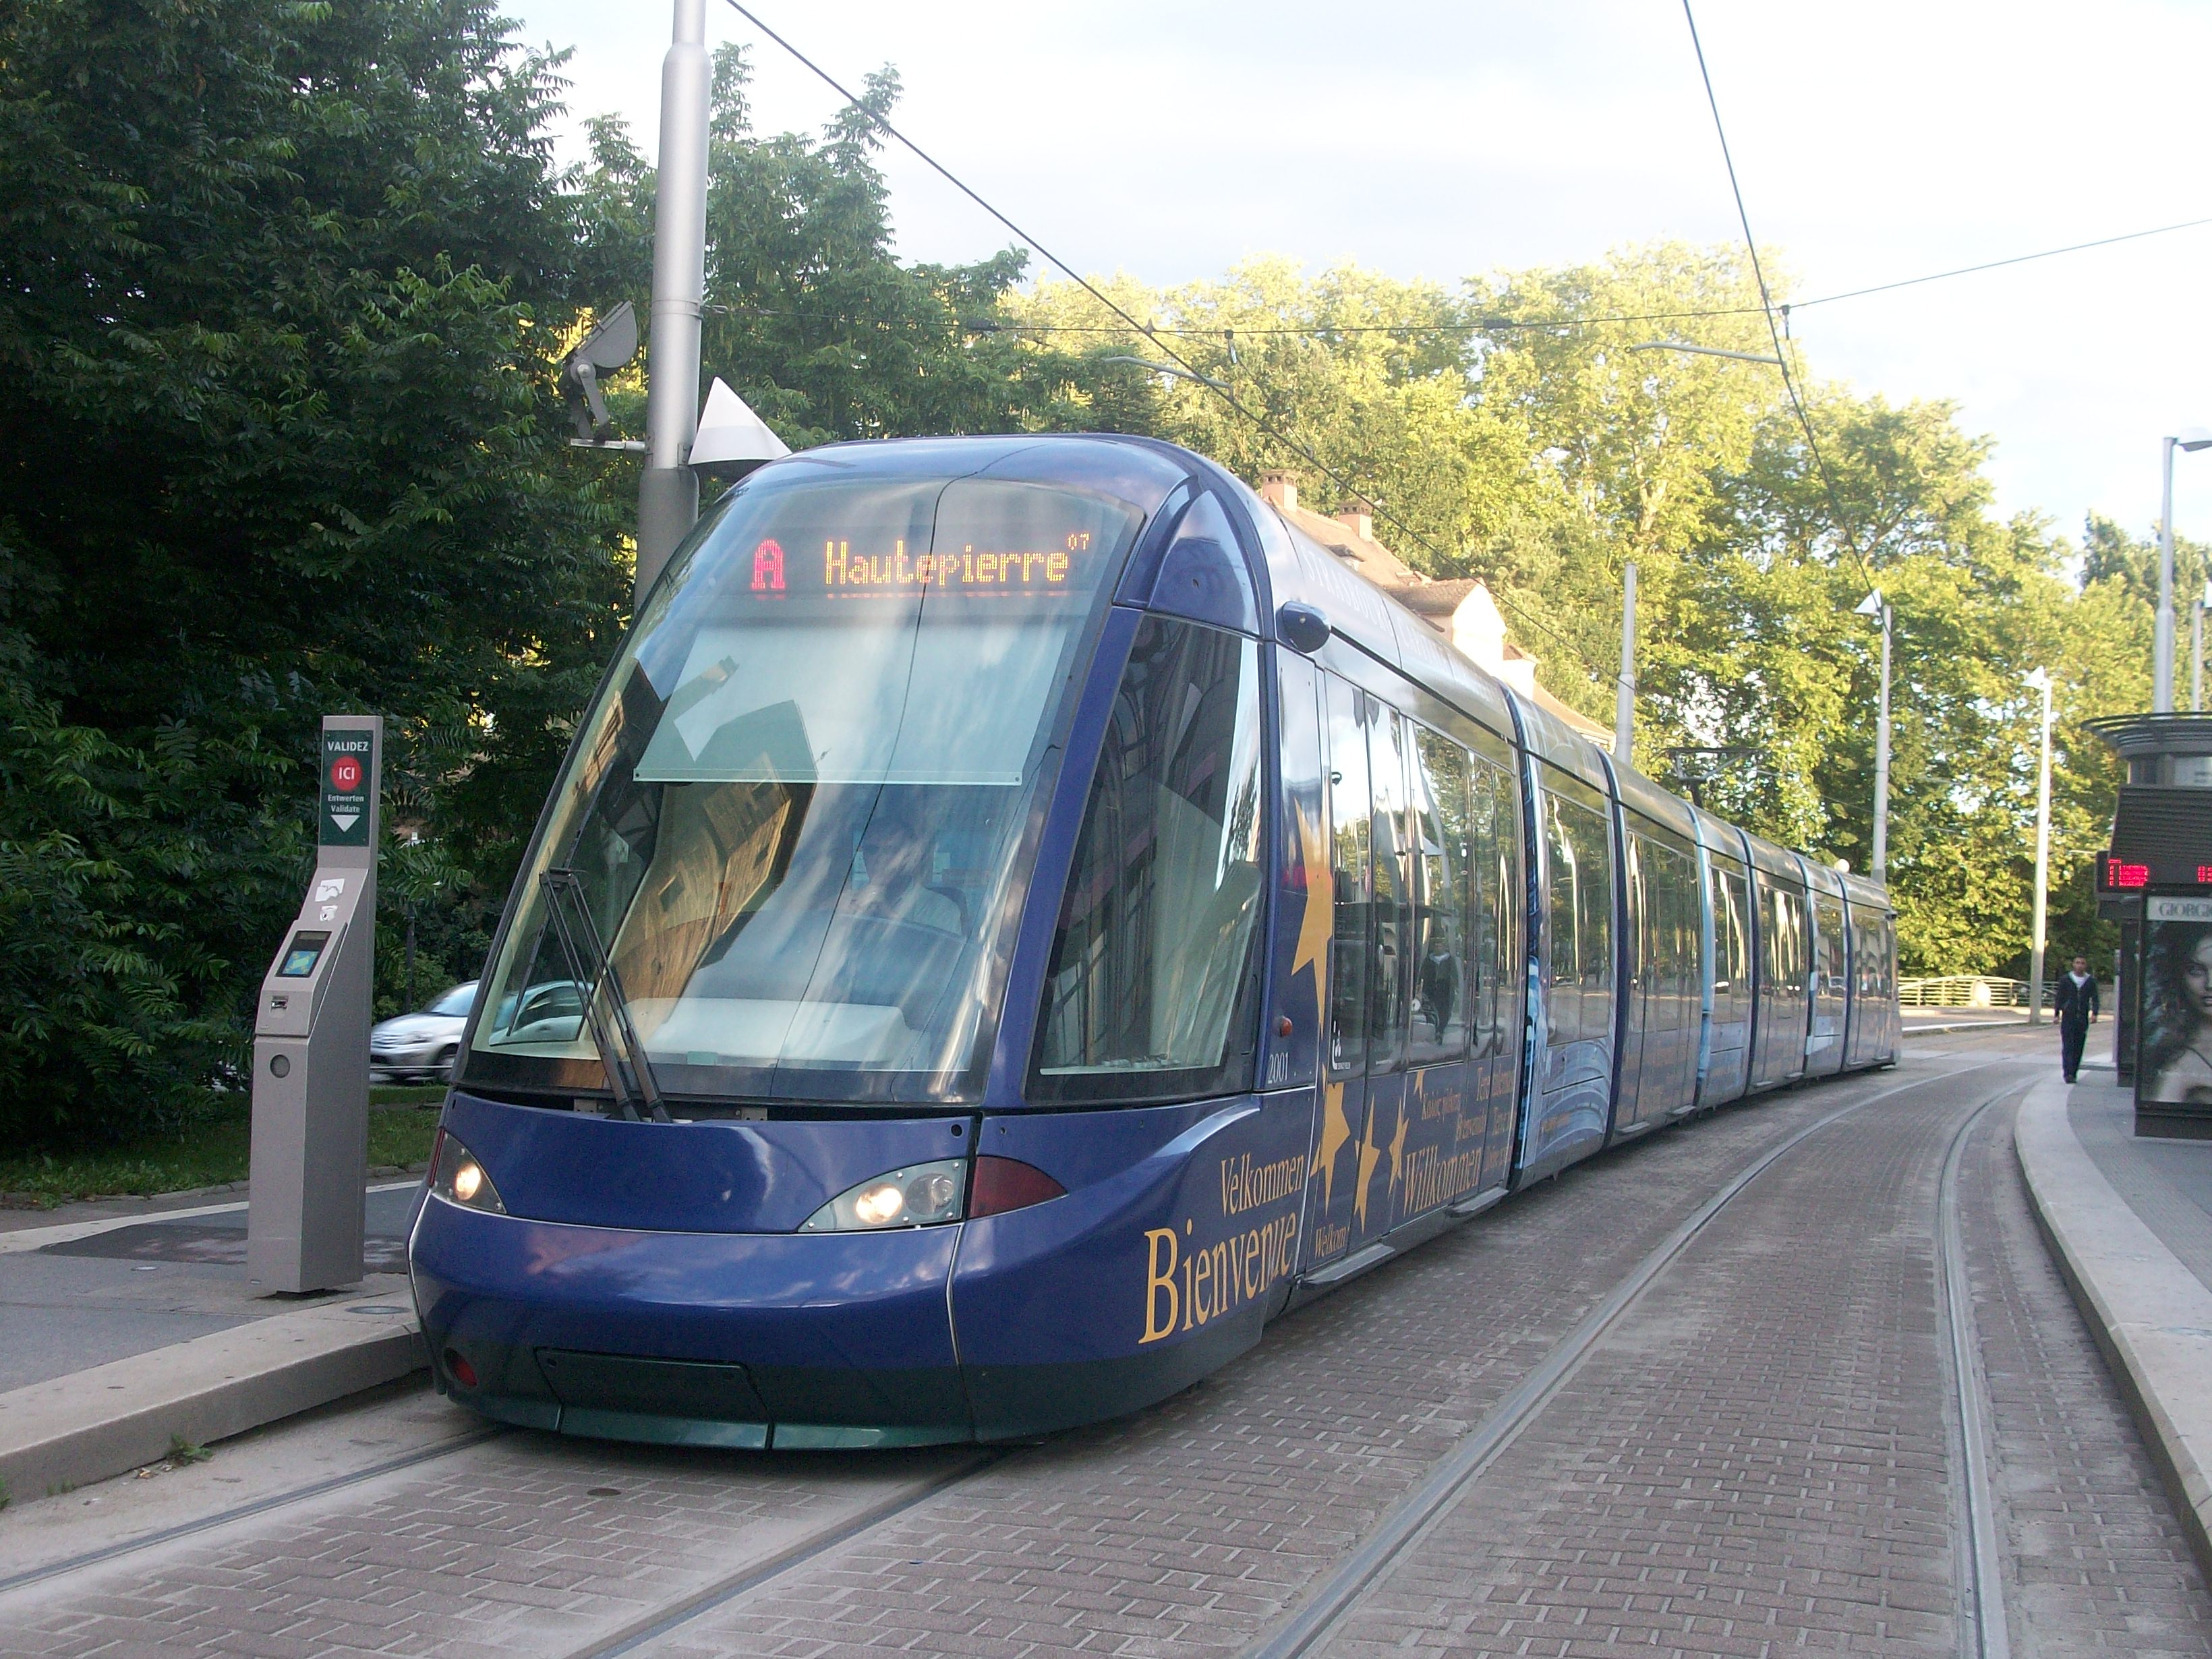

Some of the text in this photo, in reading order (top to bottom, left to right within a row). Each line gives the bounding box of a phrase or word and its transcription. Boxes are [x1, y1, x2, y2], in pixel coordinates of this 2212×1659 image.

[751, 533, 1090, 590] A Hautepierre 07
[328, 740, 369, 752] VALIDEZ
[339, 766, 355, 780] ICI
[328, 794, 365, 803] Entwerten
[330, 805, 361, 813] Validate
[2159, 902, 2212, 917] GIORGI
[1268, 1051, 1289, 1084] 2001
[1221, 1152, 1304, 1218] Velkommen
[1403, 1144, 1482, 1217] Willkommen
[1138, 1212, 1296, 1344] Bienvenue
